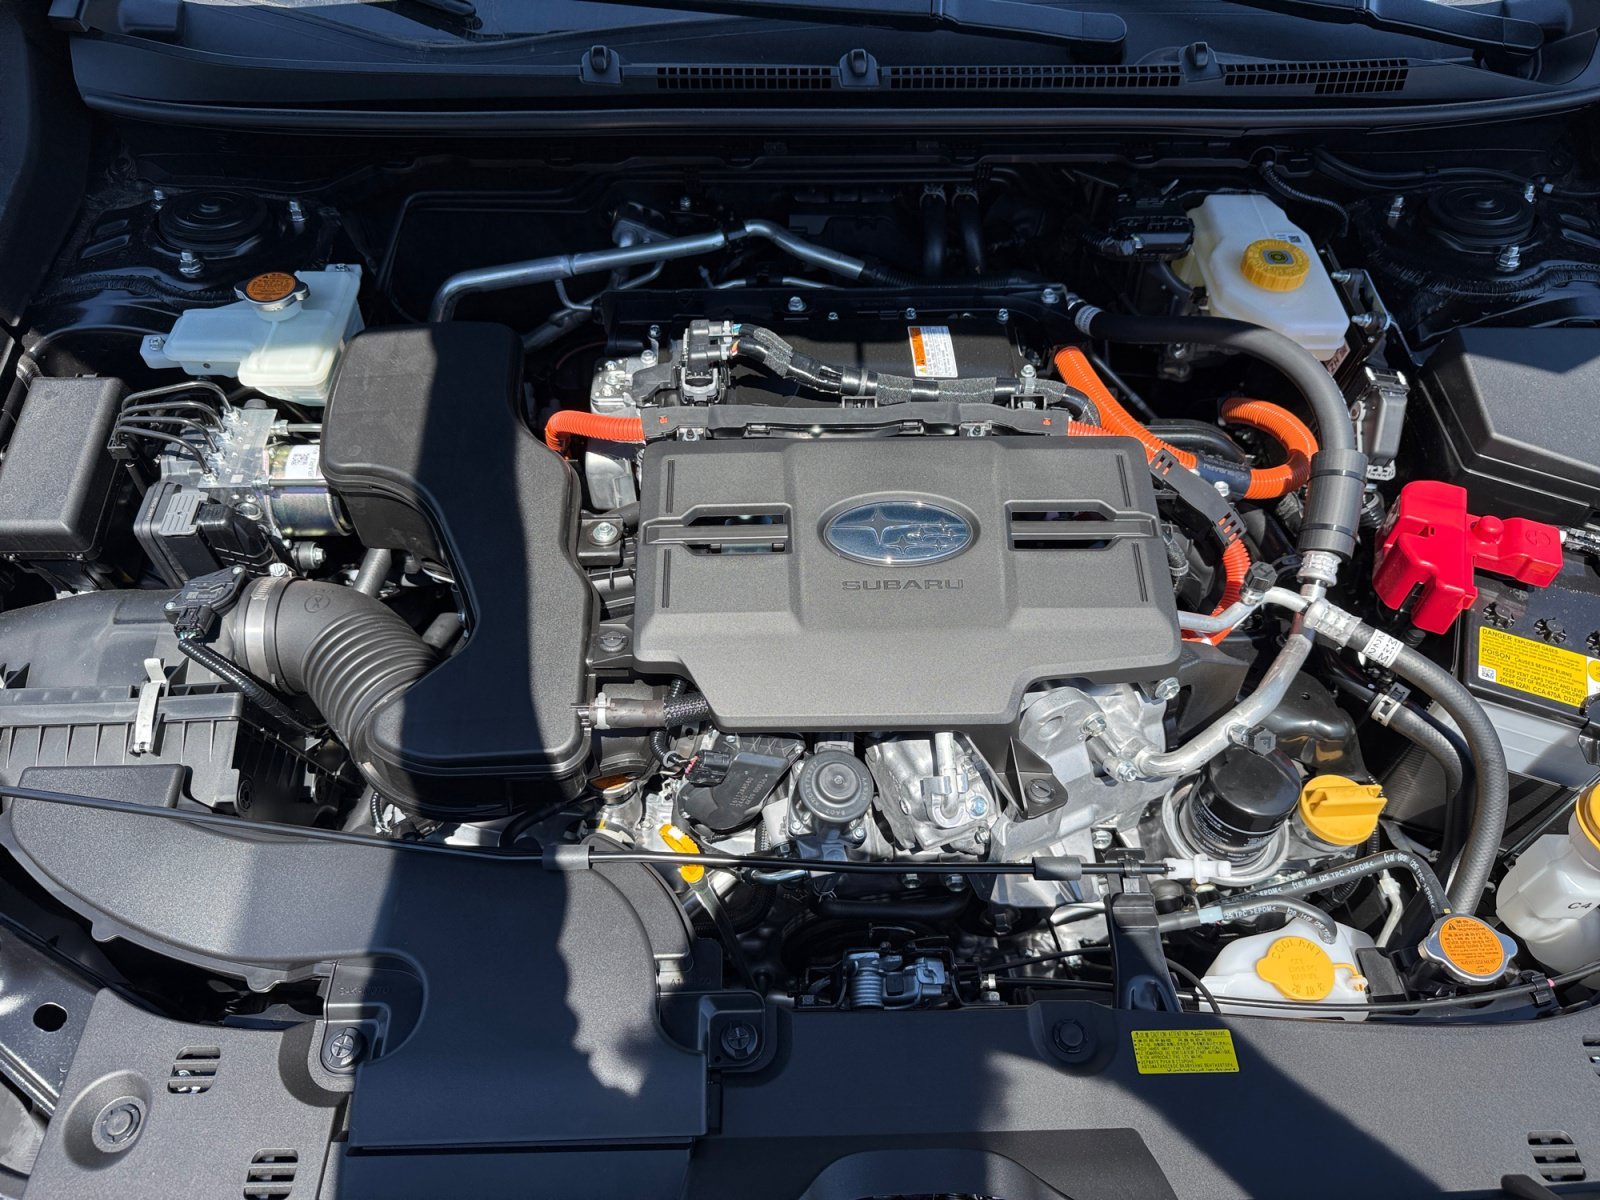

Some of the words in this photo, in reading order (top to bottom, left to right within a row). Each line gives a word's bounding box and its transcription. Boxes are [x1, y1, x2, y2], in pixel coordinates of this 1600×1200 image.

[841, 579, 963, 591] SUBARU
[1482, 629, 1512, 641] DANGER
[1514, 638, 1541, 650] EXPLOSIVE
[1542, 645, 1559, 655] GASES
[1481, 647, 1511, 661] POISON
[1515, 657, 1535, 668] CAUSES
[1535, 662, 1554, 673] SEVERE
[1555, 668, 1573, 678] BURNS
[1500, 677, 1515, 687] 20HR
[1532, 685, 1546, 695] CCA
[1503, 667, 1515, 676] KEEP
[1517, 670, 1529, 679] VENT
[1545, 677, 1559, 687] TIGHT
[1560, 682, 1571, 691] AND
[1503, 672, 1515, 681] KEEP
[1517, 675, 1527, 684] OUT
[1536, 681, 1553, 690] REACH
[1330, 870, 1345, 882] TPC
[1234, 910, 1247, 919] TPC
[1271, 938, 1322, 959] COOLANT
